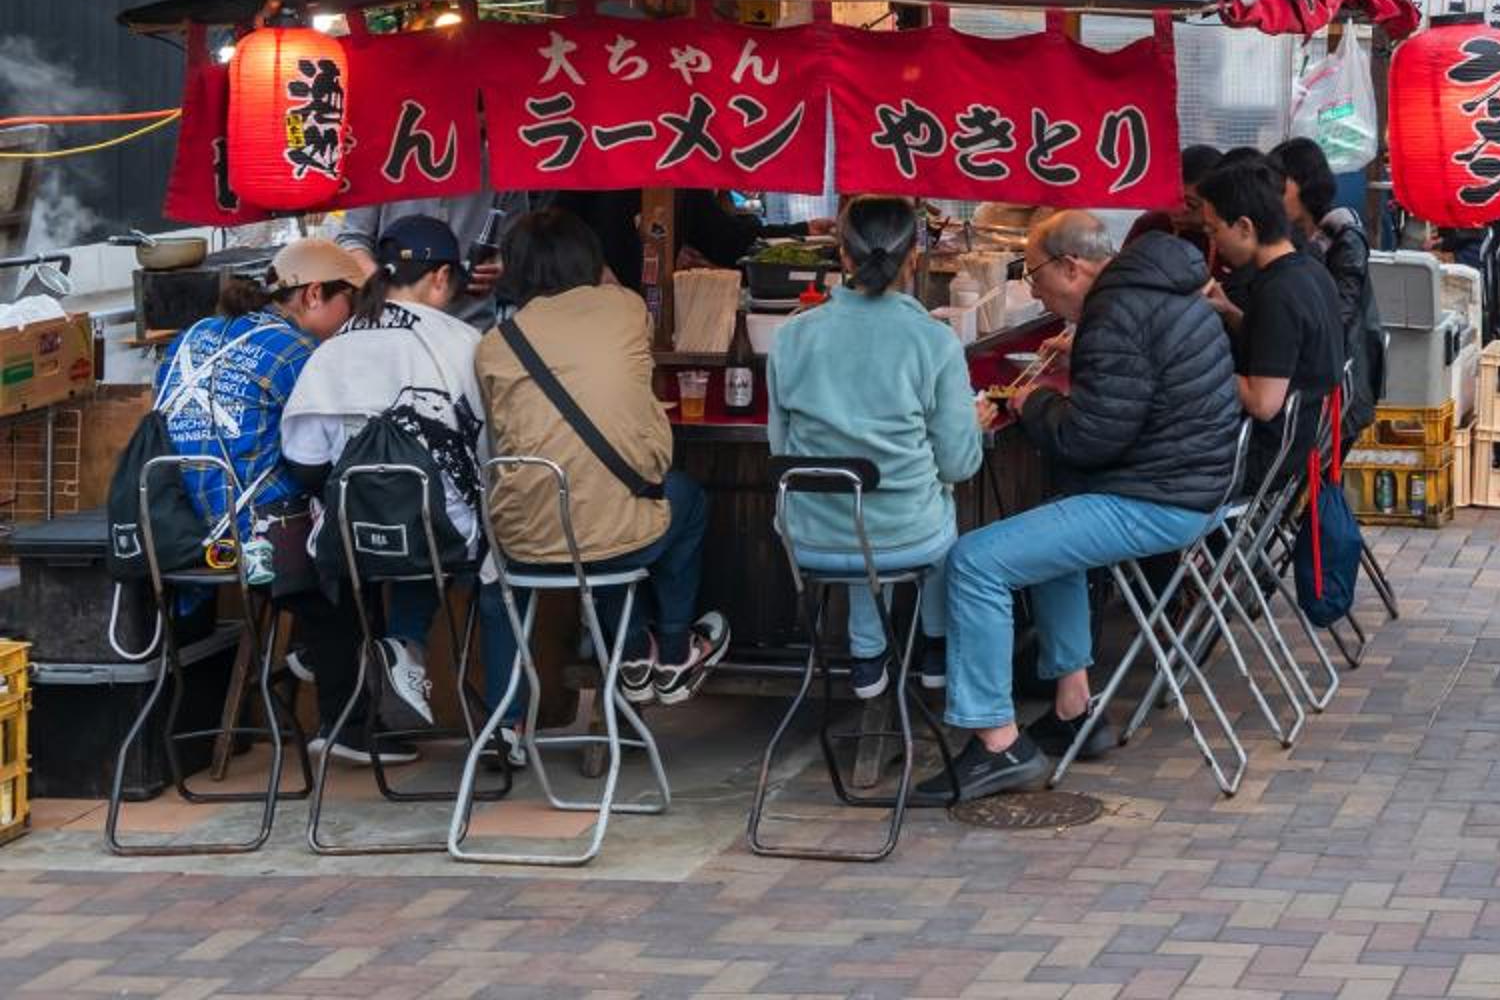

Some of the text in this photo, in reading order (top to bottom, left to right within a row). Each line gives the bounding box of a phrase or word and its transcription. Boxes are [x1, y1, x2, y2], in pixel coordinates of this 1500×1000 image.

[538, 30, 780, 86] 大ちゃん
[519, 91, 804, 172] ラーメン
[872, 96, 1150, 193] やきとり
